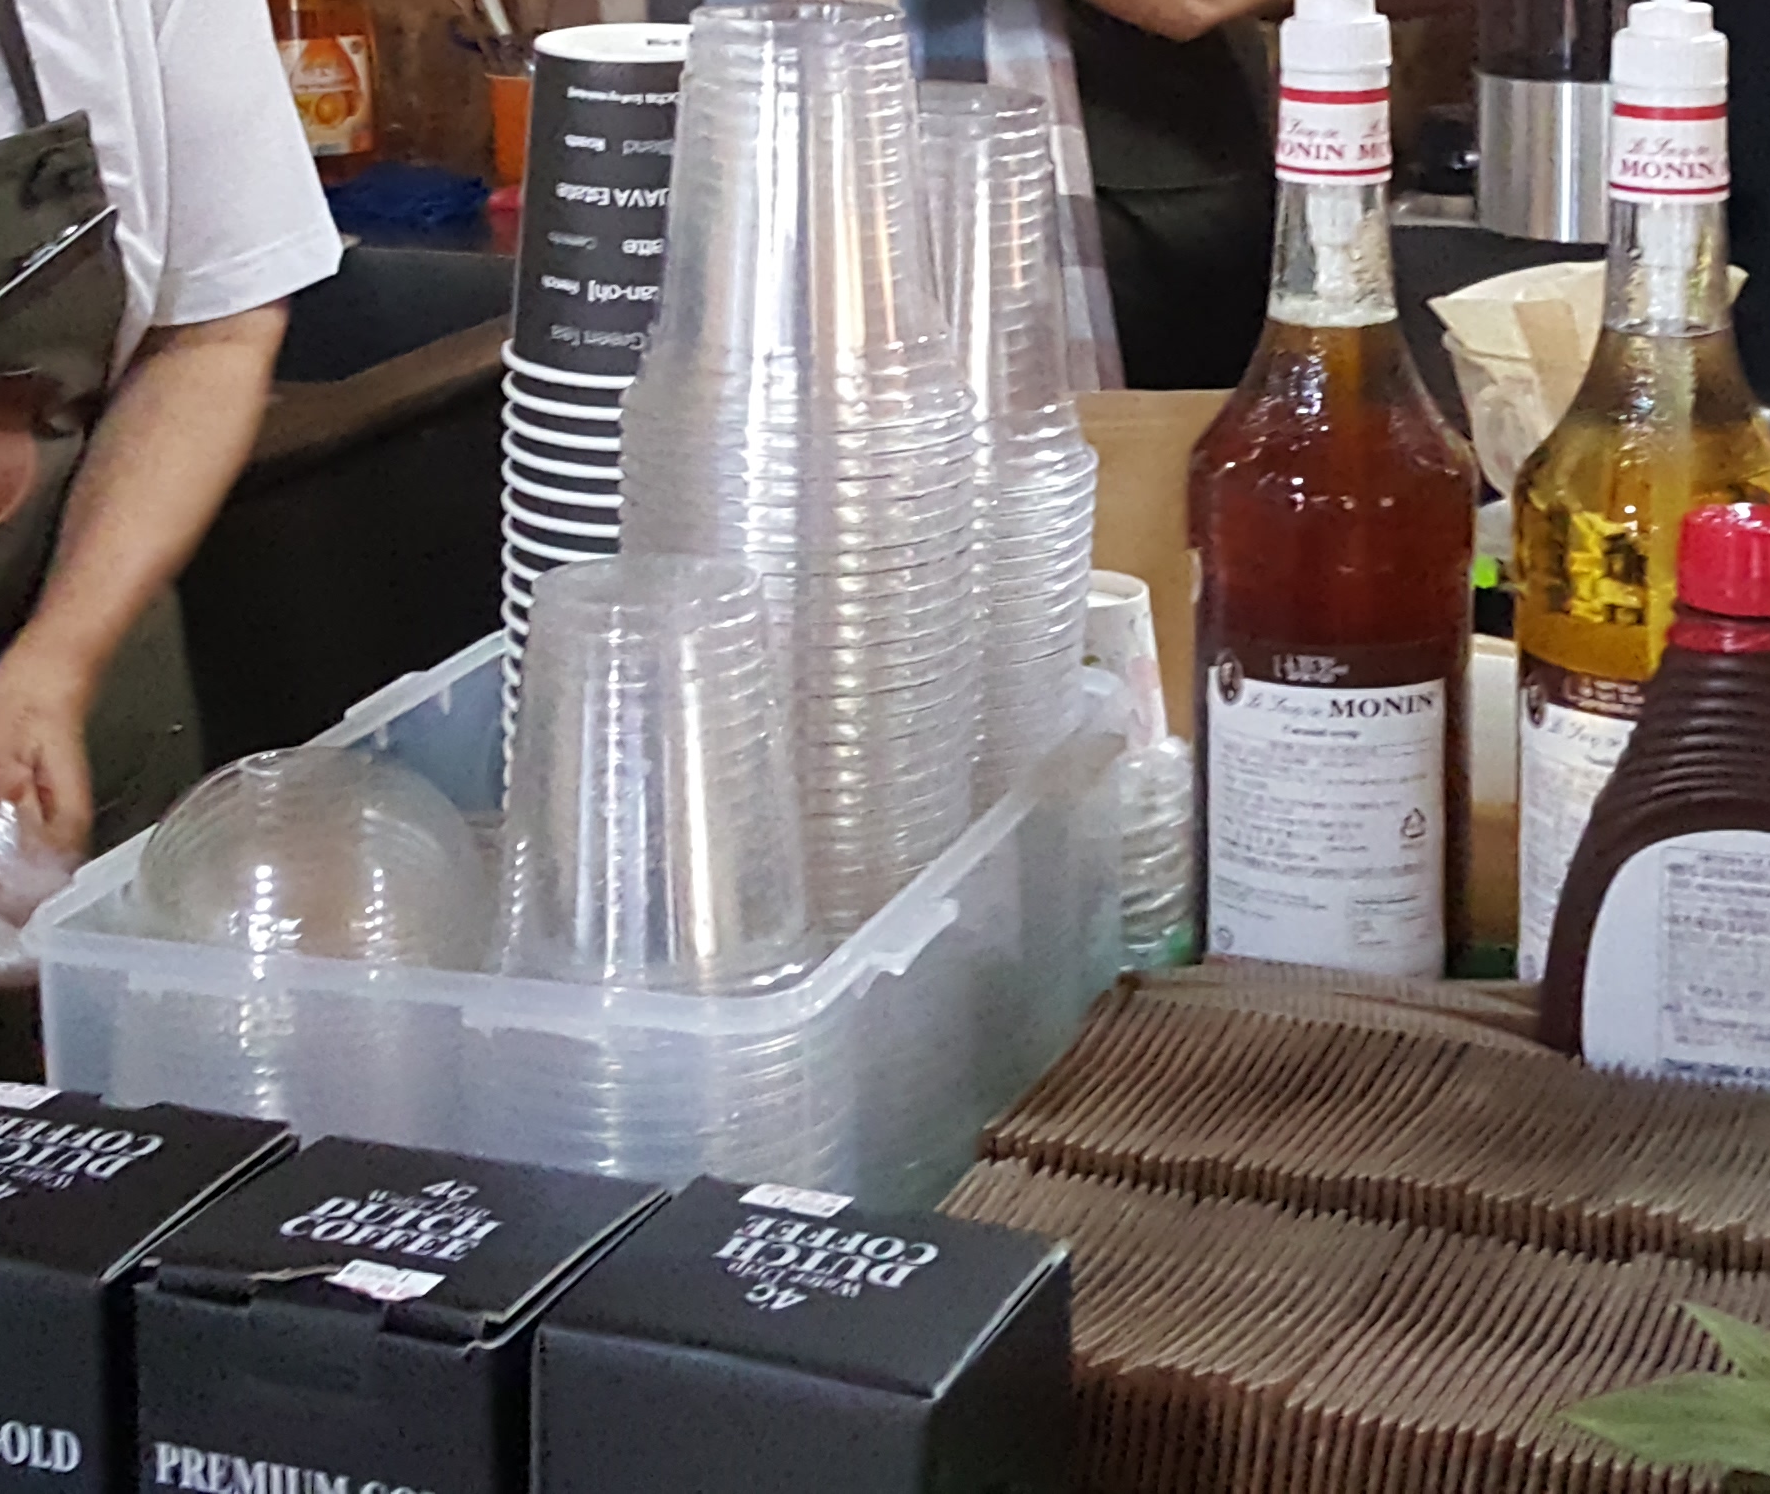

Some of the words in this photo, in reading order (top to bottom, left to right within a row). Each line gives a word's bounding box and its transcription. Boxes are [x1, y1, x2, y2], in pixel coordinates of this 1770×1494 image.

[1619, 158, 1716, 181] MONIN
[1327, 692, 1435, 719] MONIN
[733, 1214, 940, 1266] COFFEE
[712, 1236, 920, 1289] DUTCH
